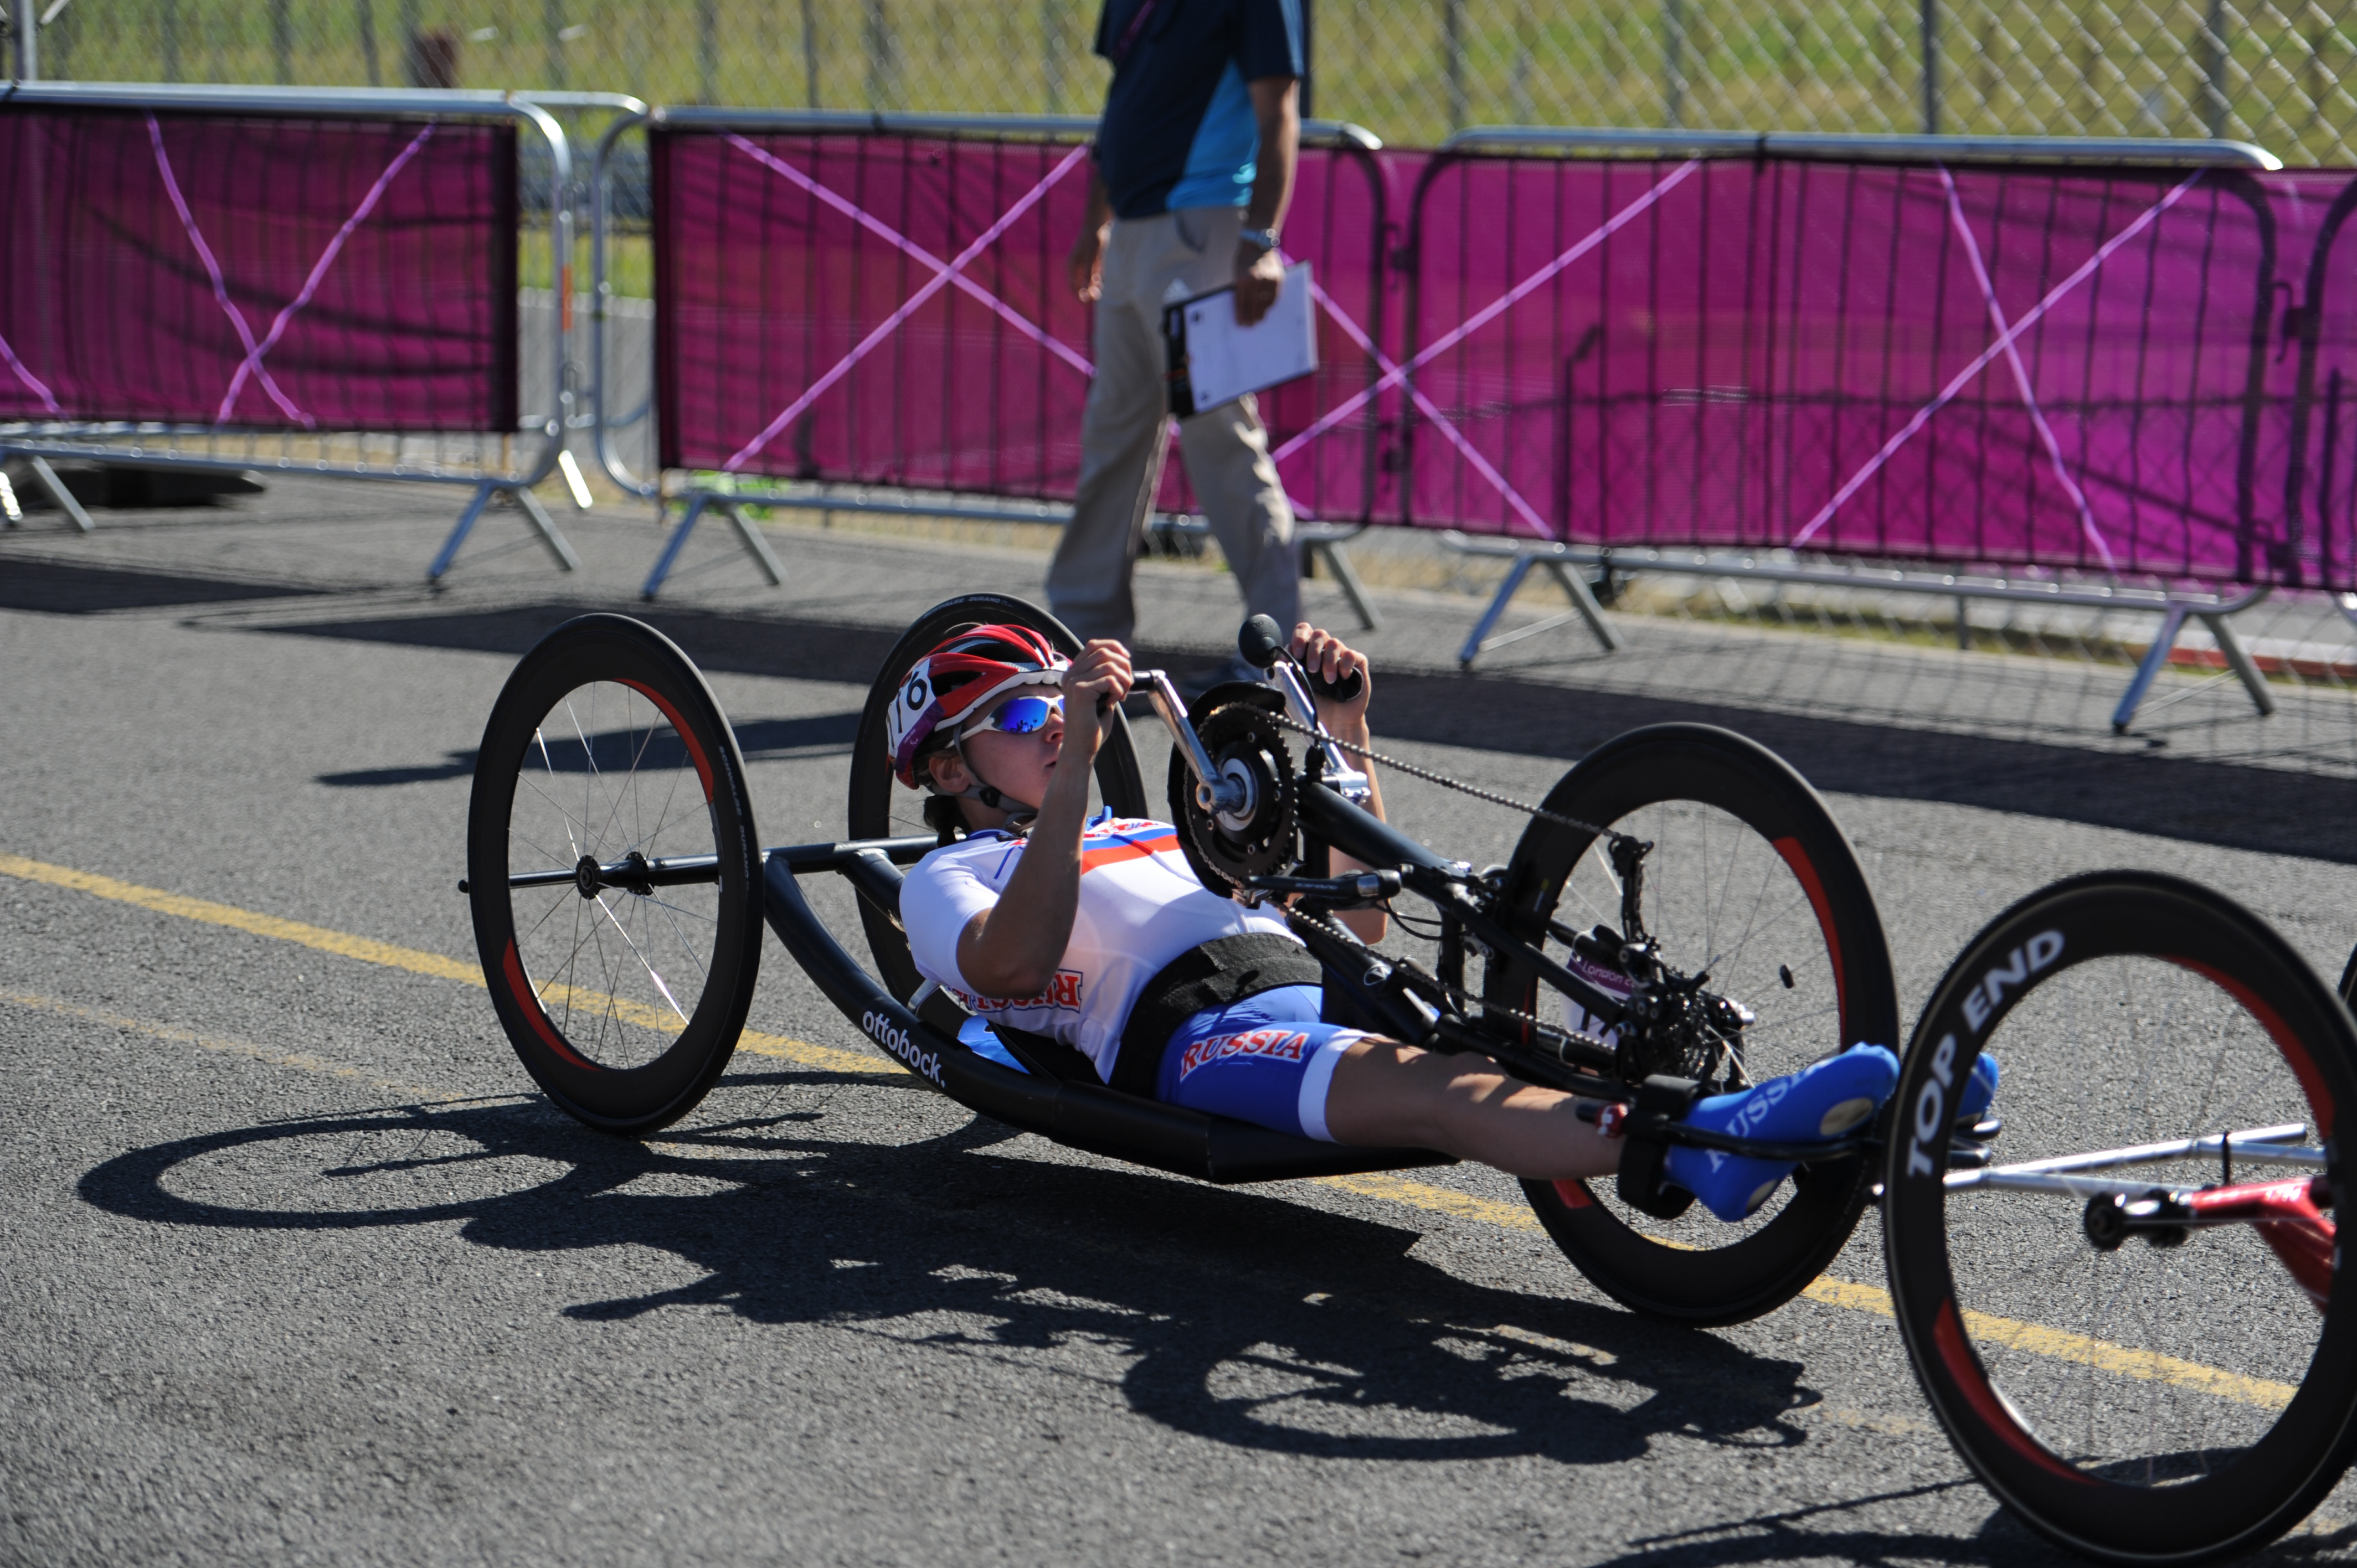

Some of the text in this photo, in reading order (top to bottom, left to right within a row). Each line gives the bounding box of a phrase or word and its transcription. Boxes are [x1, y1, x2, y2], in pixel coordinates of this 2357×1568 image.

[863, 1011, 945, 1088] ottobock.
[1180, 1029, 1310, 1084] RUSSIA
[1907, 929, 2065, 1178] TOP END
[1705, 1059, 1834, 1174] USSI
